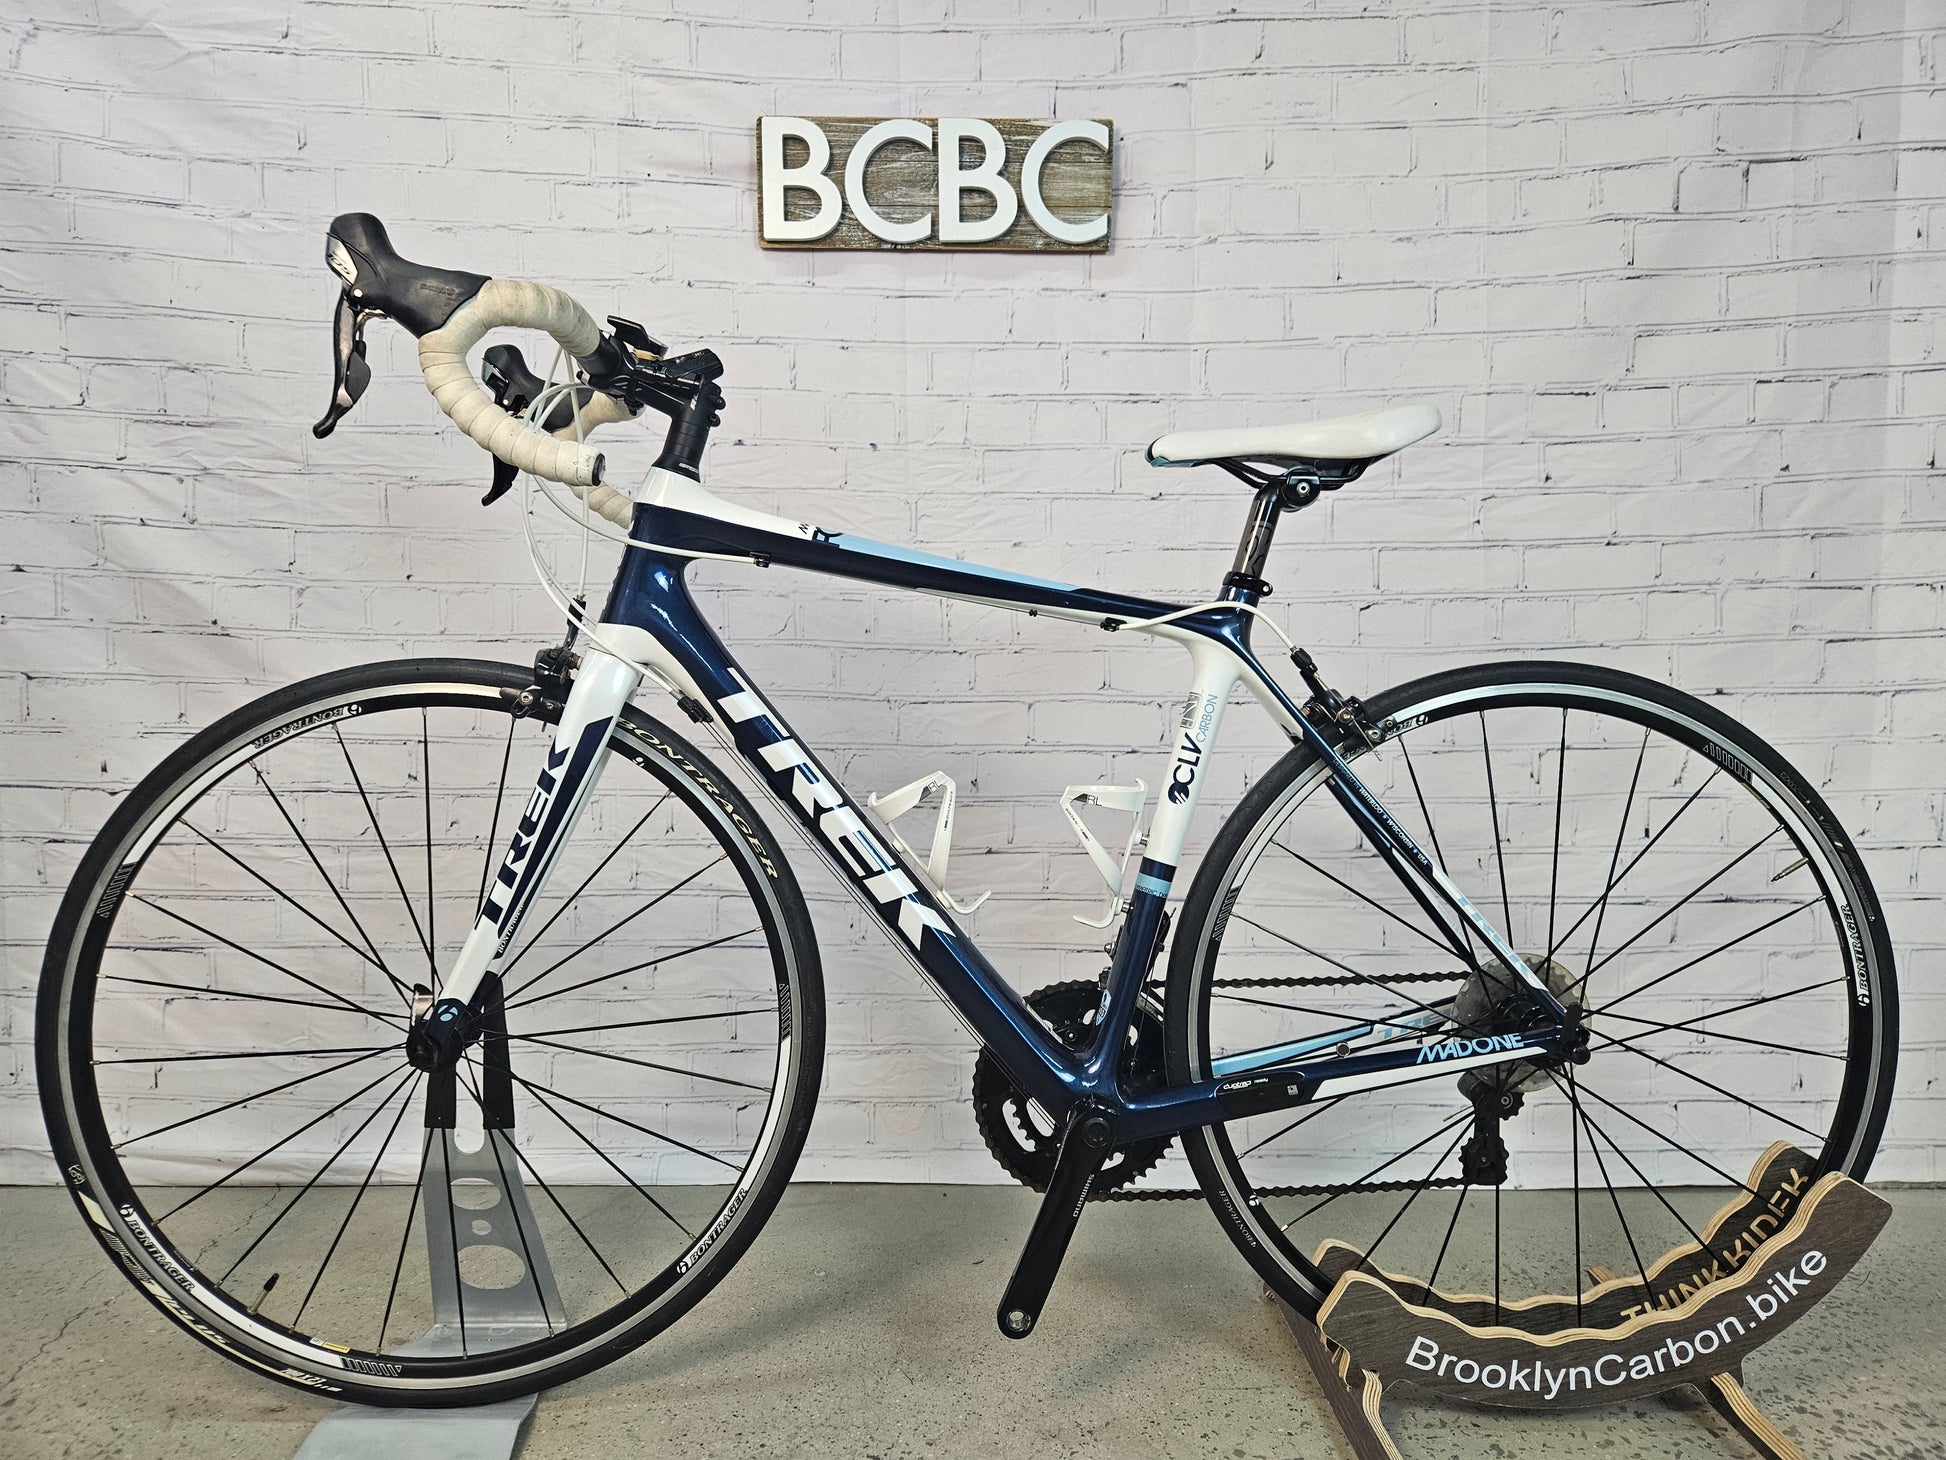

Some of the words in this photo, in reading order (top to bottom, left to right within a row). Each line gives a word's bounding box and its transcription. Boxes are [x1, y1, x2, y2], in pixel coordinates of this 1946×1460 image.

[761, 116, 1109, 244] BCBC
[254, 707, 345, 749] BONTRAGER
[1195, 694, 1218, 743] CARBON
[475, 735, 571, 930] TREK
[616, 717, 779, 879] BONTRAGER
[717, 667, 956, 951] TREK
[1359, 786, 1383, 814] WATERLOO
[1386, 818, 1414, 849] WISCONSIN
[1416, 853, 1428, 866] USA
[1841, 904, 1870, 991] BONTRAGER
[1416, 1033, 1525, 1064] MADONE
[689, 1187, 749, 1267] BONTRAGER
[1072, 1173, 1095, 1217] SHIMANO
[1218, 1190, 1255, 1242] BONTRAGER
[127, 1219, 197, 1293] BONTRAGER
[1405, 1250, 1827, 1400] BrooklynCarbon.bike
